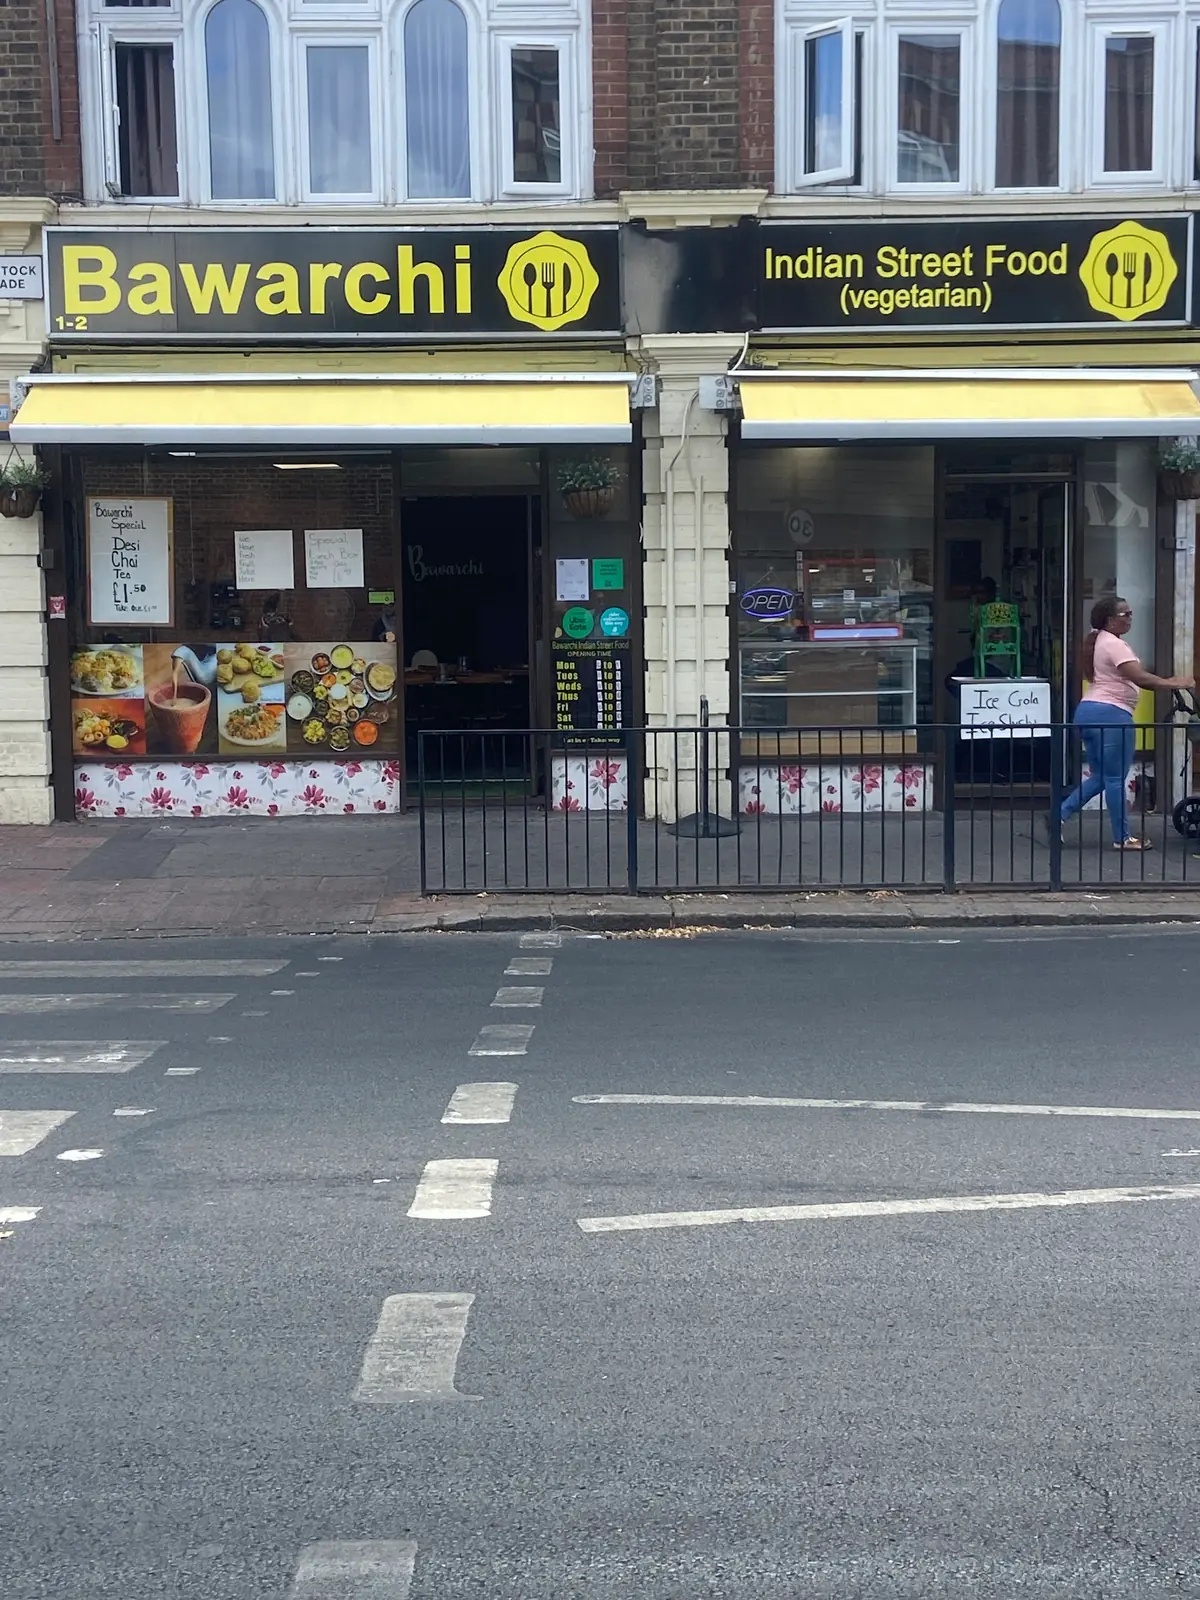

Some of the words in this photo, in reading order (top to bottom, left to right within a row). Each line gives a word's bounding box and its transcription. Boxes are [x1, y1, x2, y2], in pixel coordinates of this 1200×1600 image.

[765, 247, 863, 280] Indian
[876, 244, 974, 279] Street
[985, 243, 1068, 276] Food
[62, 245, 472, 315] Bawarchi
[840, 281, 992, 315] (vegetarian)
[55, 315, 89, 331] 1-2
[95, 502, 133, 518] Bawarchi
[111, 536, 140, 551] Desi
[111, 551, 138, 568] Chai
[408, 544, 484, 582] Bawarchi
[113, 568, 131, 579] Tea
[740, 594, 795, 611] OPEN
[552, 641, 577, 650] Bawarchi
[578, 641, 596, 650] Indian
[597, 641, 614, 650] Street
[614, 641, 630, 650] Food
[556, 661, 575, 670] Mon
[603, 661, 613, 670] to
[556, 671, 578, 680] Tues
[603, 671, 613, 680] to
[556, 681, 582, 691] Weds
[603, 681, 613, 691] to
[556, 692, 579, 701] Thus
[603, 692, 613, 701] to
[972, 689, 999, 710] Ice
[603, 702, 613, 711] to
[556, 713, 572, 722] Sat
[603, 713, 613, 722] to
